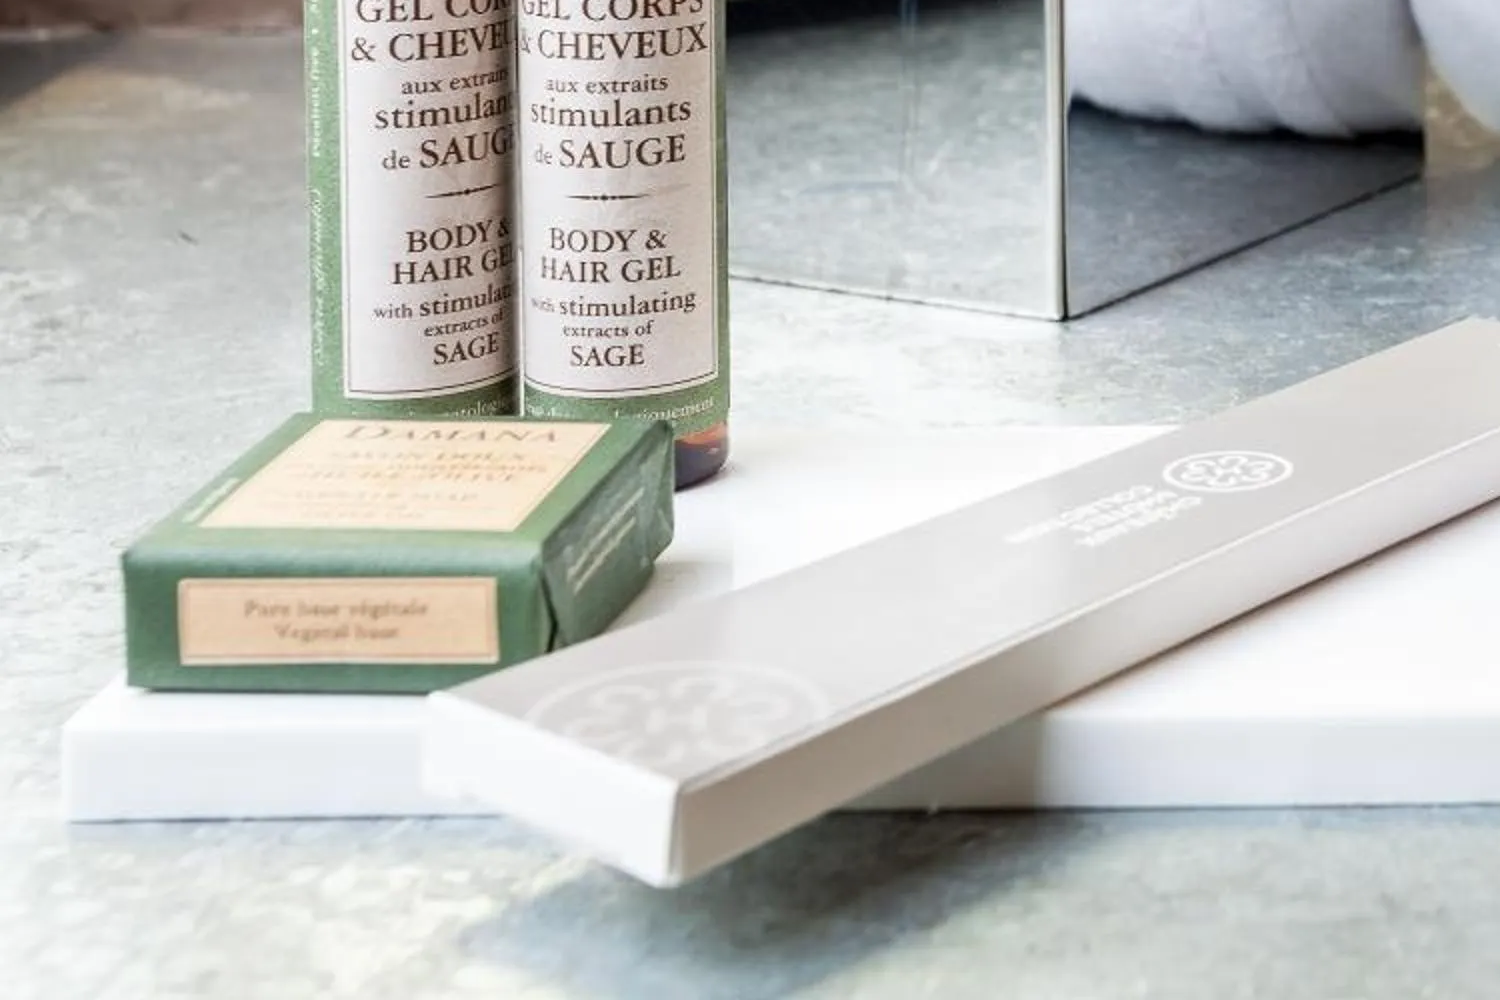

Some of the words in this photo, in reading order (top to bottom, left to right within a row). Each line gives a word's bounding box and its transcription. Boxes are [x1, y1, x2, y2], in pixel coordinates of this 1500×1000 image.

[351, 36, 376, 62] &
[537, 22, 709, 61] CHEVEUX
[401, 76, 440, 96] aux
[546, 77, 578, 93] aux
[586, 74, 669, 94] extraits
[531, 99, 692, 129] stimulants
[382, 149, 410, 170] de
[534, 143, 553, 165] de
[558, 133, 687, 171] SAUGE
[406, 219, 492, 253] BODY
[550, 228, 638, 254] BODY
[645, 229, 667, 250] &
[392, 256, 474, 285] HAIR
[481, 243, 513, 272] GE
[540, 255, 611, 284] HAIR
[621, 256, 681, 283] GEL
[374, 303, 413, 321] with
[559, 290, 697, 318] stimulating
[424, 317, 489, 337] extracts
[562, 321, 629, 338] extracts
[635, 319, 655, 338] of
[433, 332, 500, 365] SAGE
[569, 344, 645, 368] SAGE
[344, 425, 557, 443] DAMANA
